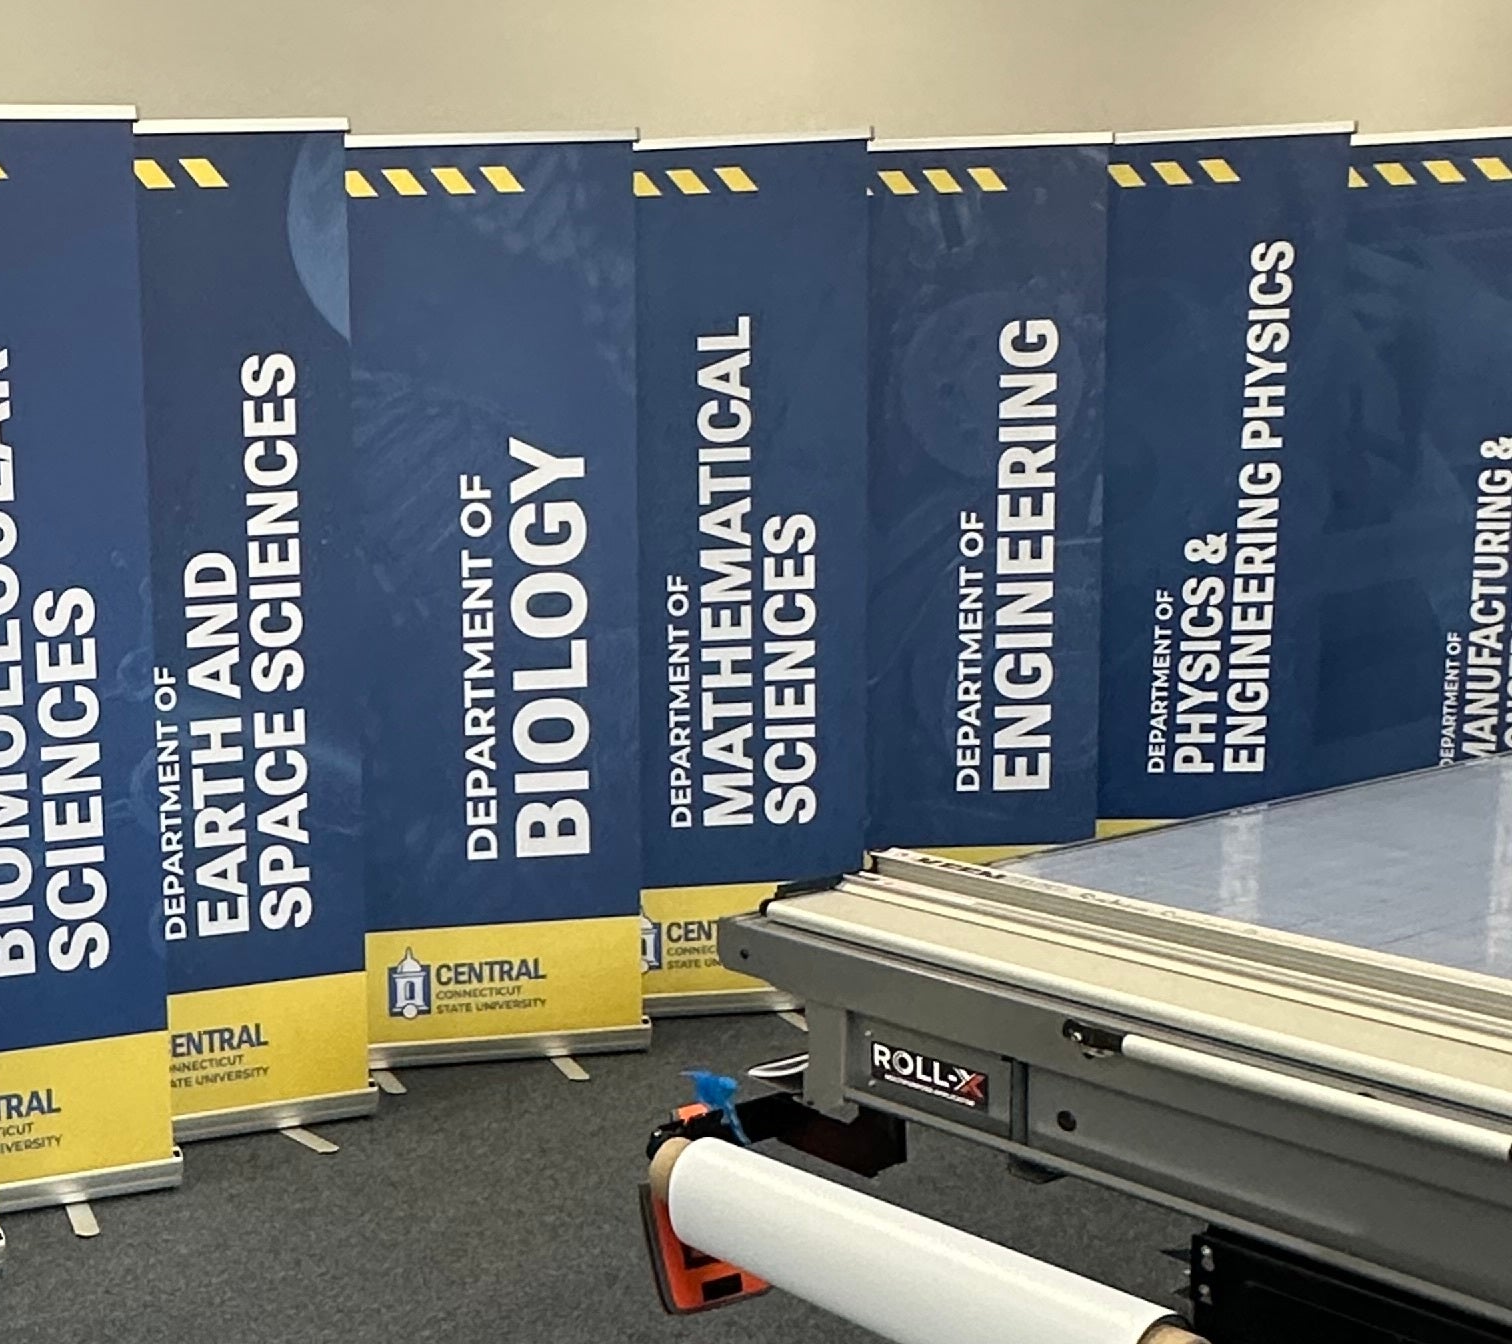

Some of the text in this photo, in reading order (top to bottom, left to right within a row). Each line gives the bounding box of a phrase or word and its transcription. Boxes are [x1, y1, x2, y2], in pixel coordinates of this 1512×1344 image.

[240, 353, 313, 930] SPACE SCIENCES
[696, 315, 754, 827] MATHEMATICAL
[992, 319, 1059, 791] ENGINEERING
[1222, 240, 1295, 772] ENGINEERING PHYSICS
[32, 587, 110, 972] SCIENCES
[183, 552, 250, 937] EARTH AND
[459, 474, 498, 861] DEPARTMENT OF
[508, 436, 591, 858] BIOLOGY
[666, 574, 692, 828] DEPARTMENT OF
[762, 514, 817, 824] SCIENCES
[956, 510, 985, 792] DEPARTMENT OF
[1147, 589, 1174, 774] DEPARTMENT OF
[1173, 532, 1228, 773] PHYSICS &
[1446, 632, 1462, 656] OF
[153, 666, 187, 941] DEPARTMENT OF
[170, 1023, 269, 1058] ENTRAL
[195, 1066, 269, 1085] UNIVERSITY
[435, 957, 547, 986] CENTRAL
[436, 985, 522, 1000] CONNECTICUT
[436, 998, 547, 1014] STATE UNIVERSITY
[872, 1042, 986, 1098] ROLL-X
